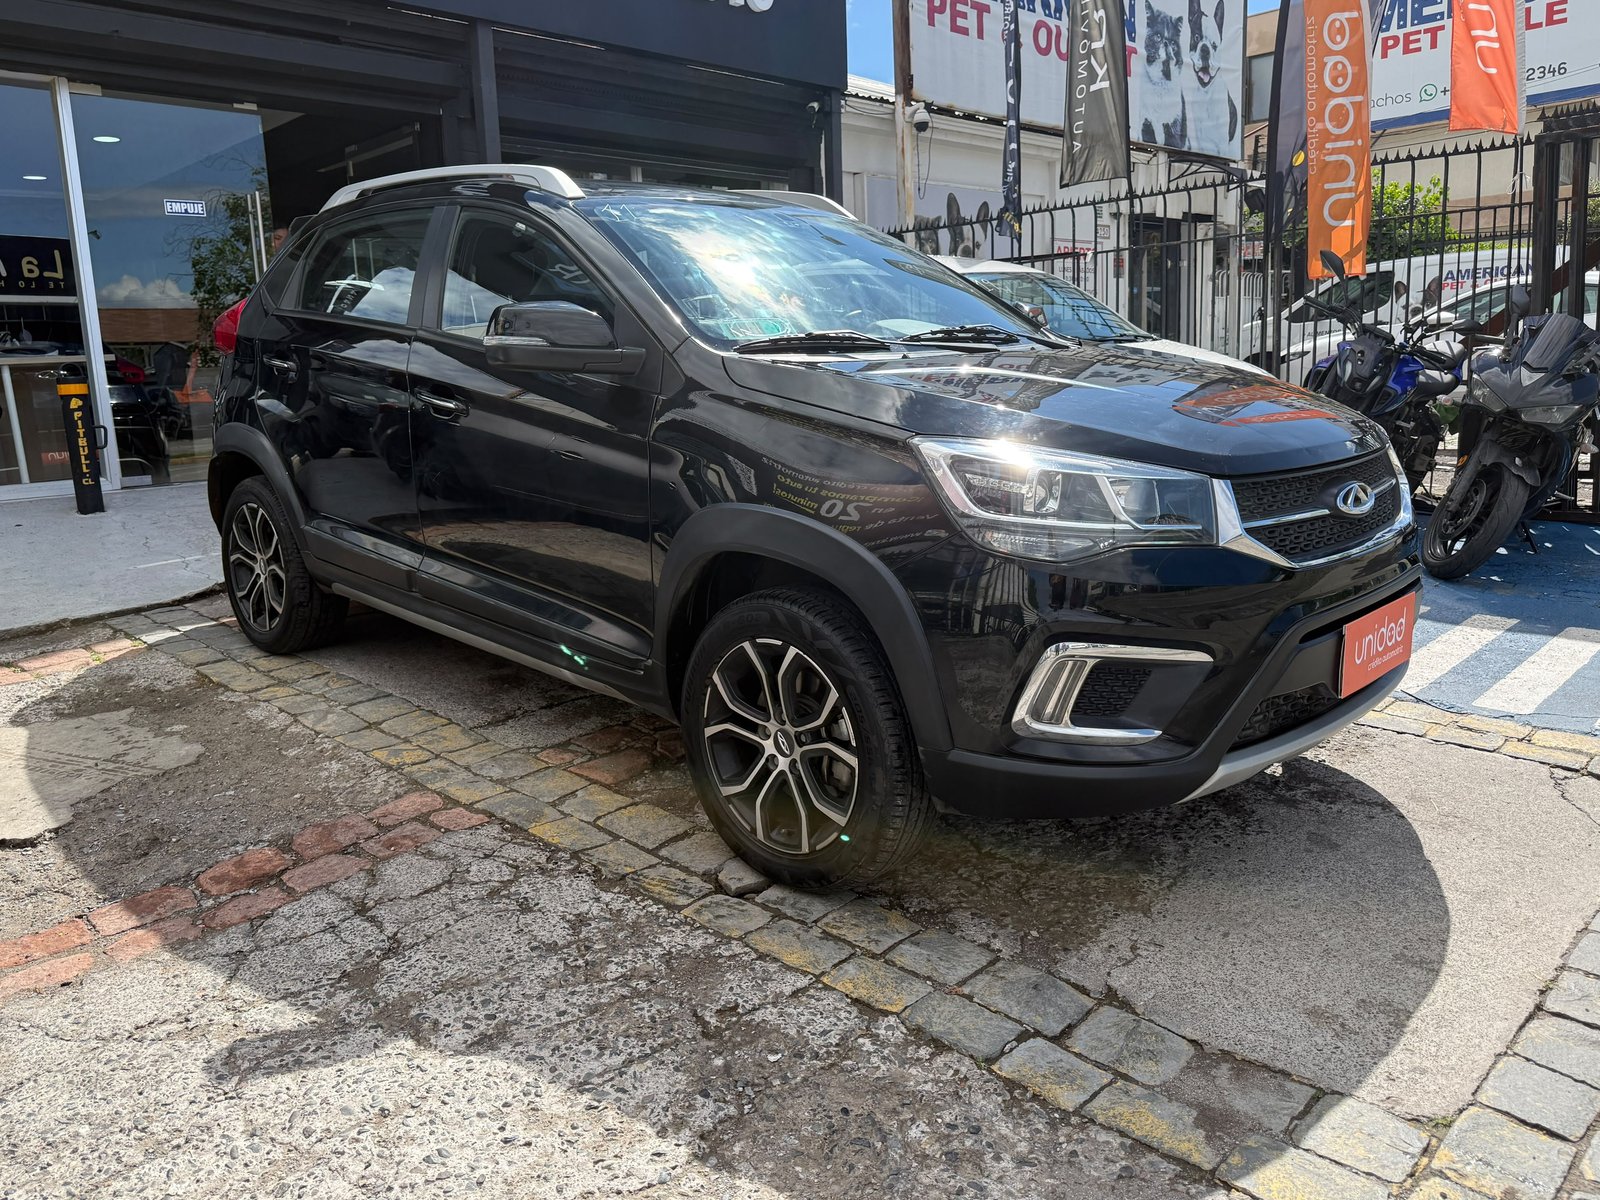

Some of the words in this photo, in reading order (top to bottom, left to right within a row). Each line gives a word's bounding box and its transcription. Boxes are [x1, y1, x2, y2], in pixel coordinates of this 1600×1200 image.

[927, 0, 991, 41] PET
[1380, 24, 1446, 60] PET
[166, 201, 205, 215] EMPUJE
[1355, 606, 1407, 664] unidad
